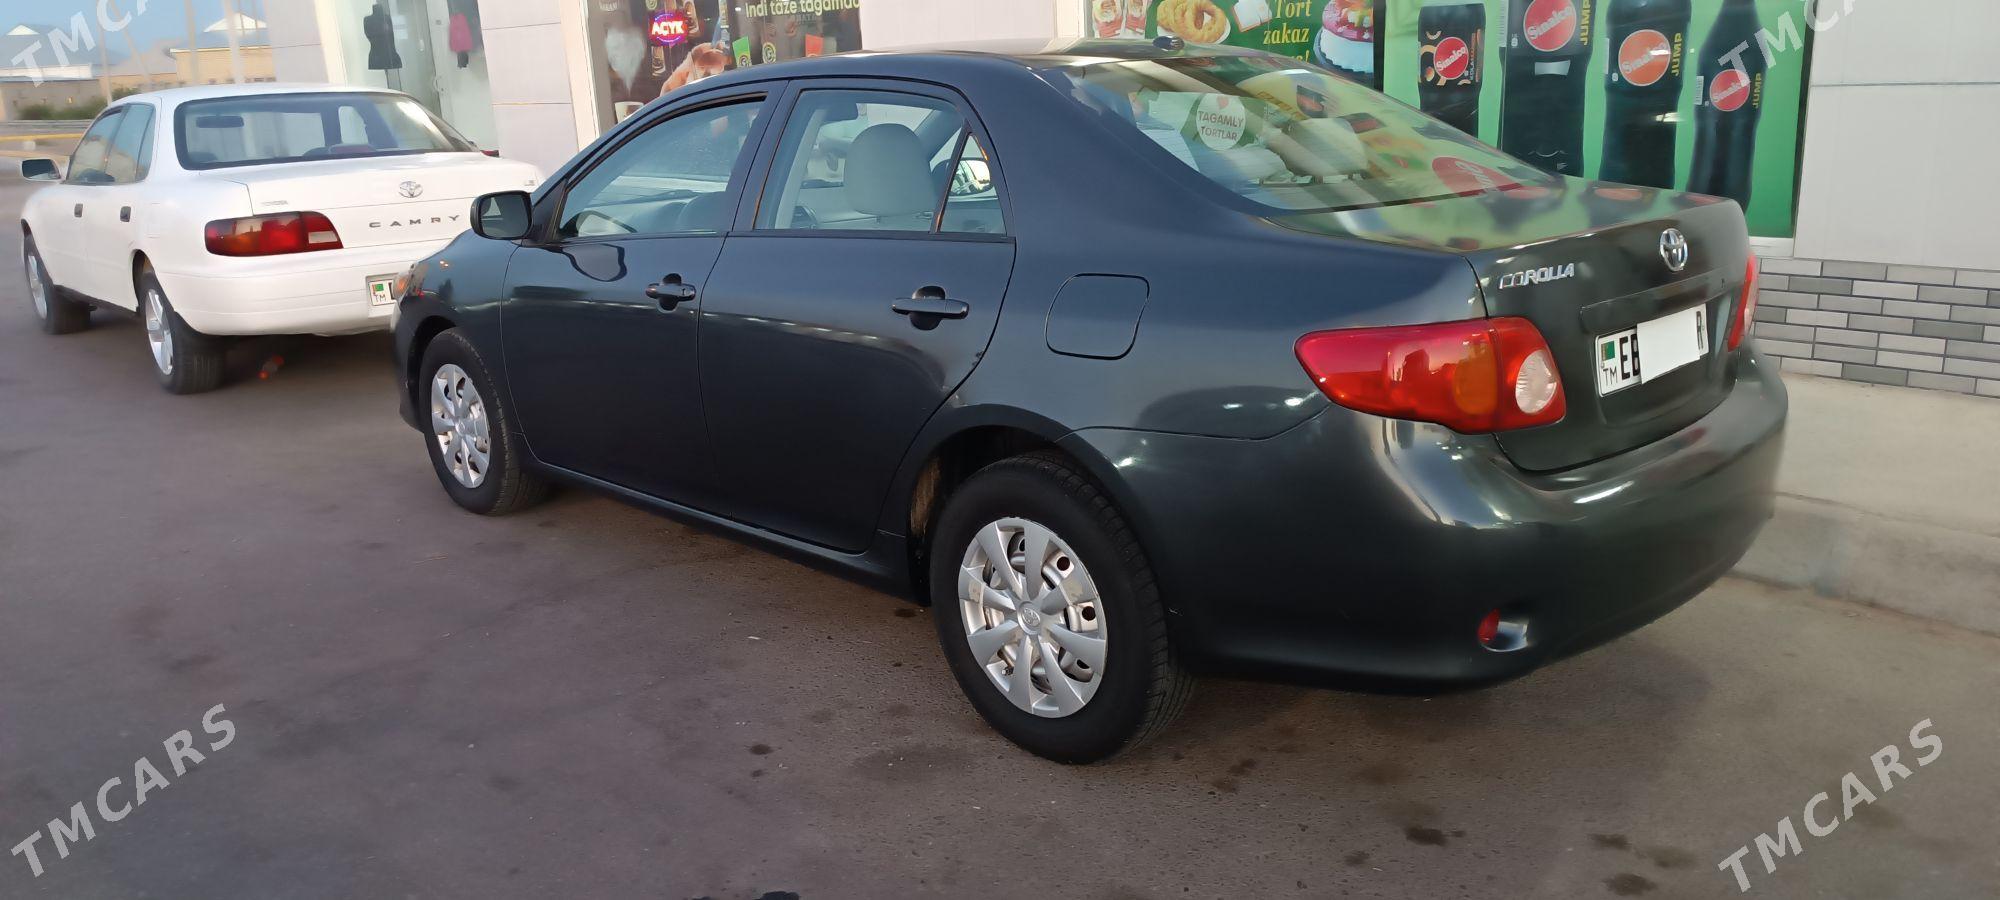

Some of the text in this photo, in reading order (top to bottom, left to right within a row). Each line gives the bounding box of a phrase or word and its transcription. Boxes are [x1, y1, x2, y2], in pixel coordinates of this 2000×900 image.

[1274, 0, 1312, 19] Tort
[1263, 23, 1310, 45] zakaz
[1527, 6, 1573, 40] Sinalco
[1580, 0, 1591, 46] JUMP
[1436, 46, 1466, 71] Sinalco
[1671, 33, 1682, 77] JUMP
[1753, 73, 1762, 109] JUMP
[1198, 111, 1244, 128] TAGAMLY
[1201, 126, 1238, 141] TORTLAR
[369, 215, 459, 228] CAMRY
[1499, 263, 1575, 289] COROLLA
[1603, 367, 1618, 386] TM
